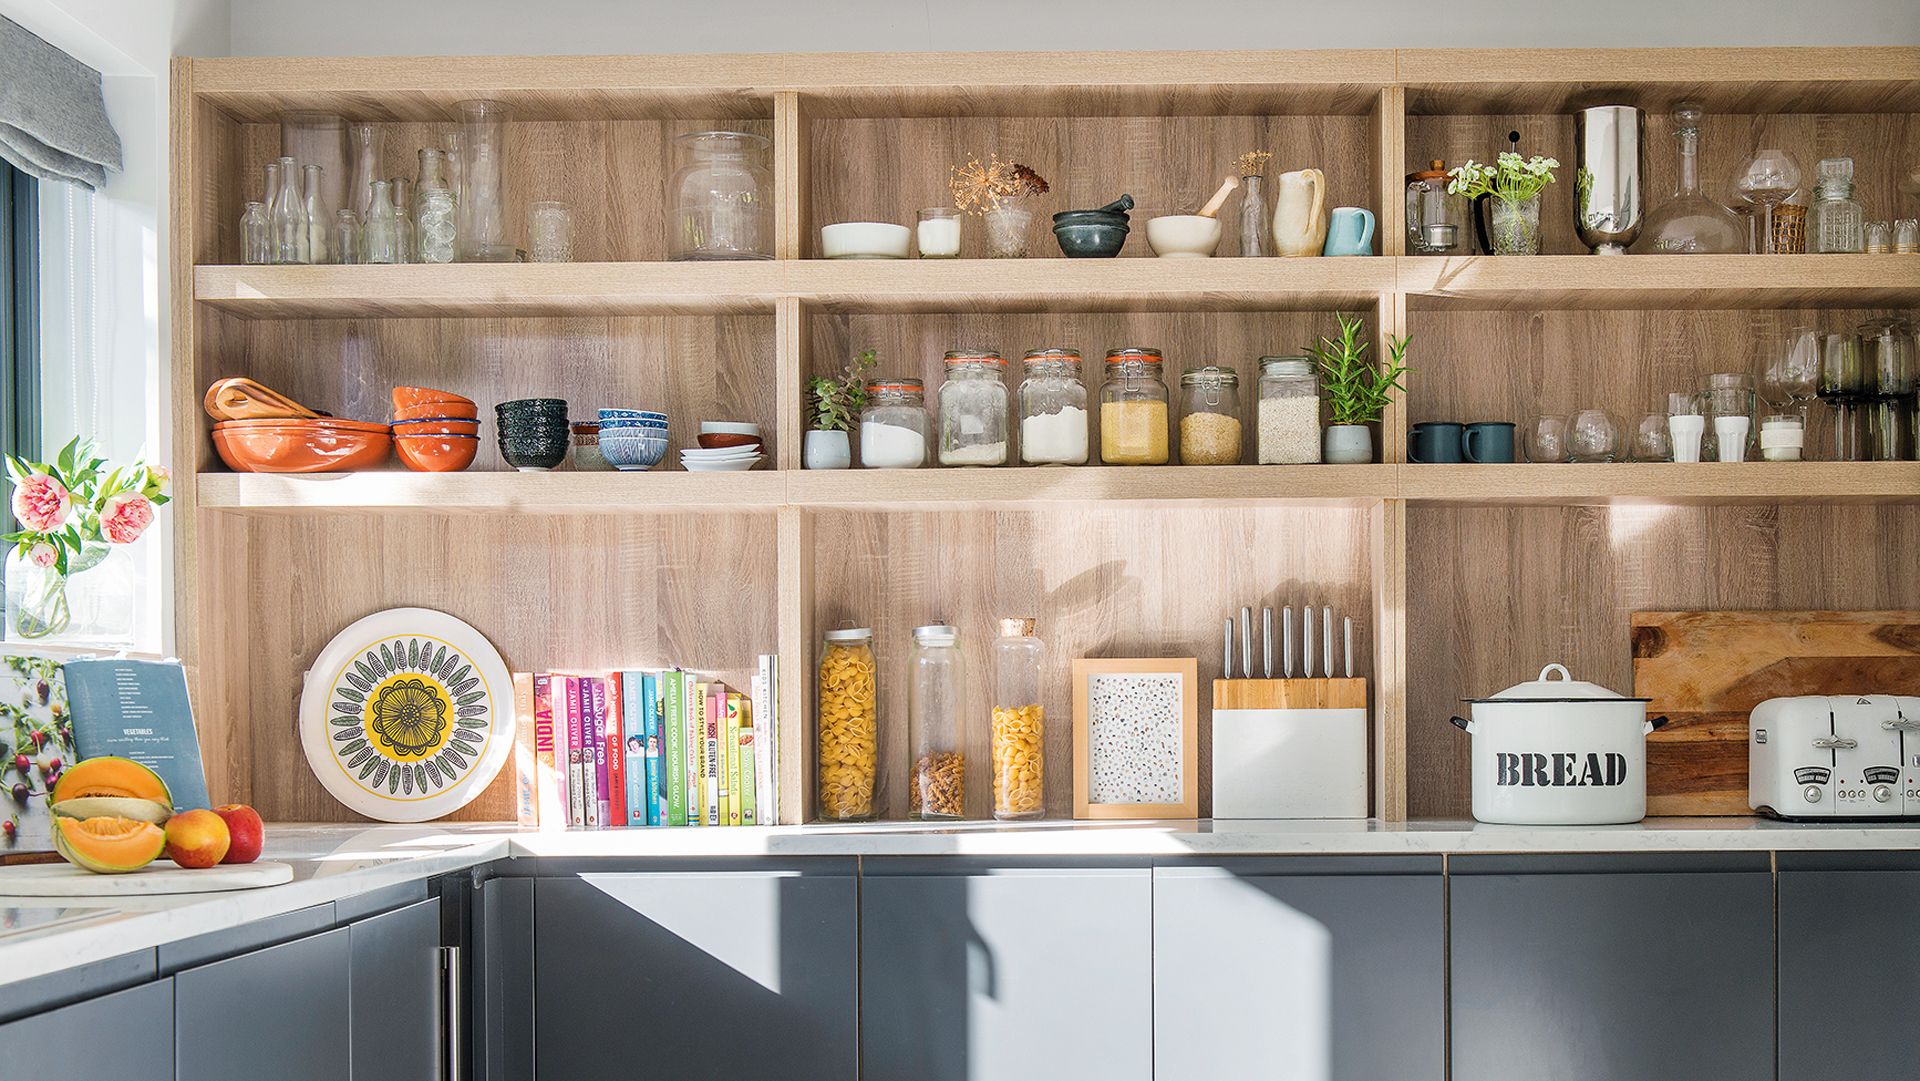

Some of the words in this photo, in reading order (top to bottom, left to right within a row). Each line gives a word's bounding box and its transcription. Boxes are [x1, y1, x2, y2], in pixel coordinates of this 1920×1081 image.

[569, 690, 577, 715] JAMIE
[582, 689, 591, 713] JAMIE
[669, 678, 677, 704] AMELIA
[536, 709, 554, 752] INDIA
[570, 717, 579, 747] OLIVER
[584, 716, 592, 745] OLIVER
[593, 707, 605, 738] Sugar
[707, 722, 716, 739] NOSH
[596, 741, 605, 765] Free
[612, 736, 618, 747] OF
[611, 748, 619, 770] FOOD
[1496, 752, 1627, 787] BREAD
[730, 771, 739, 796] Salads
